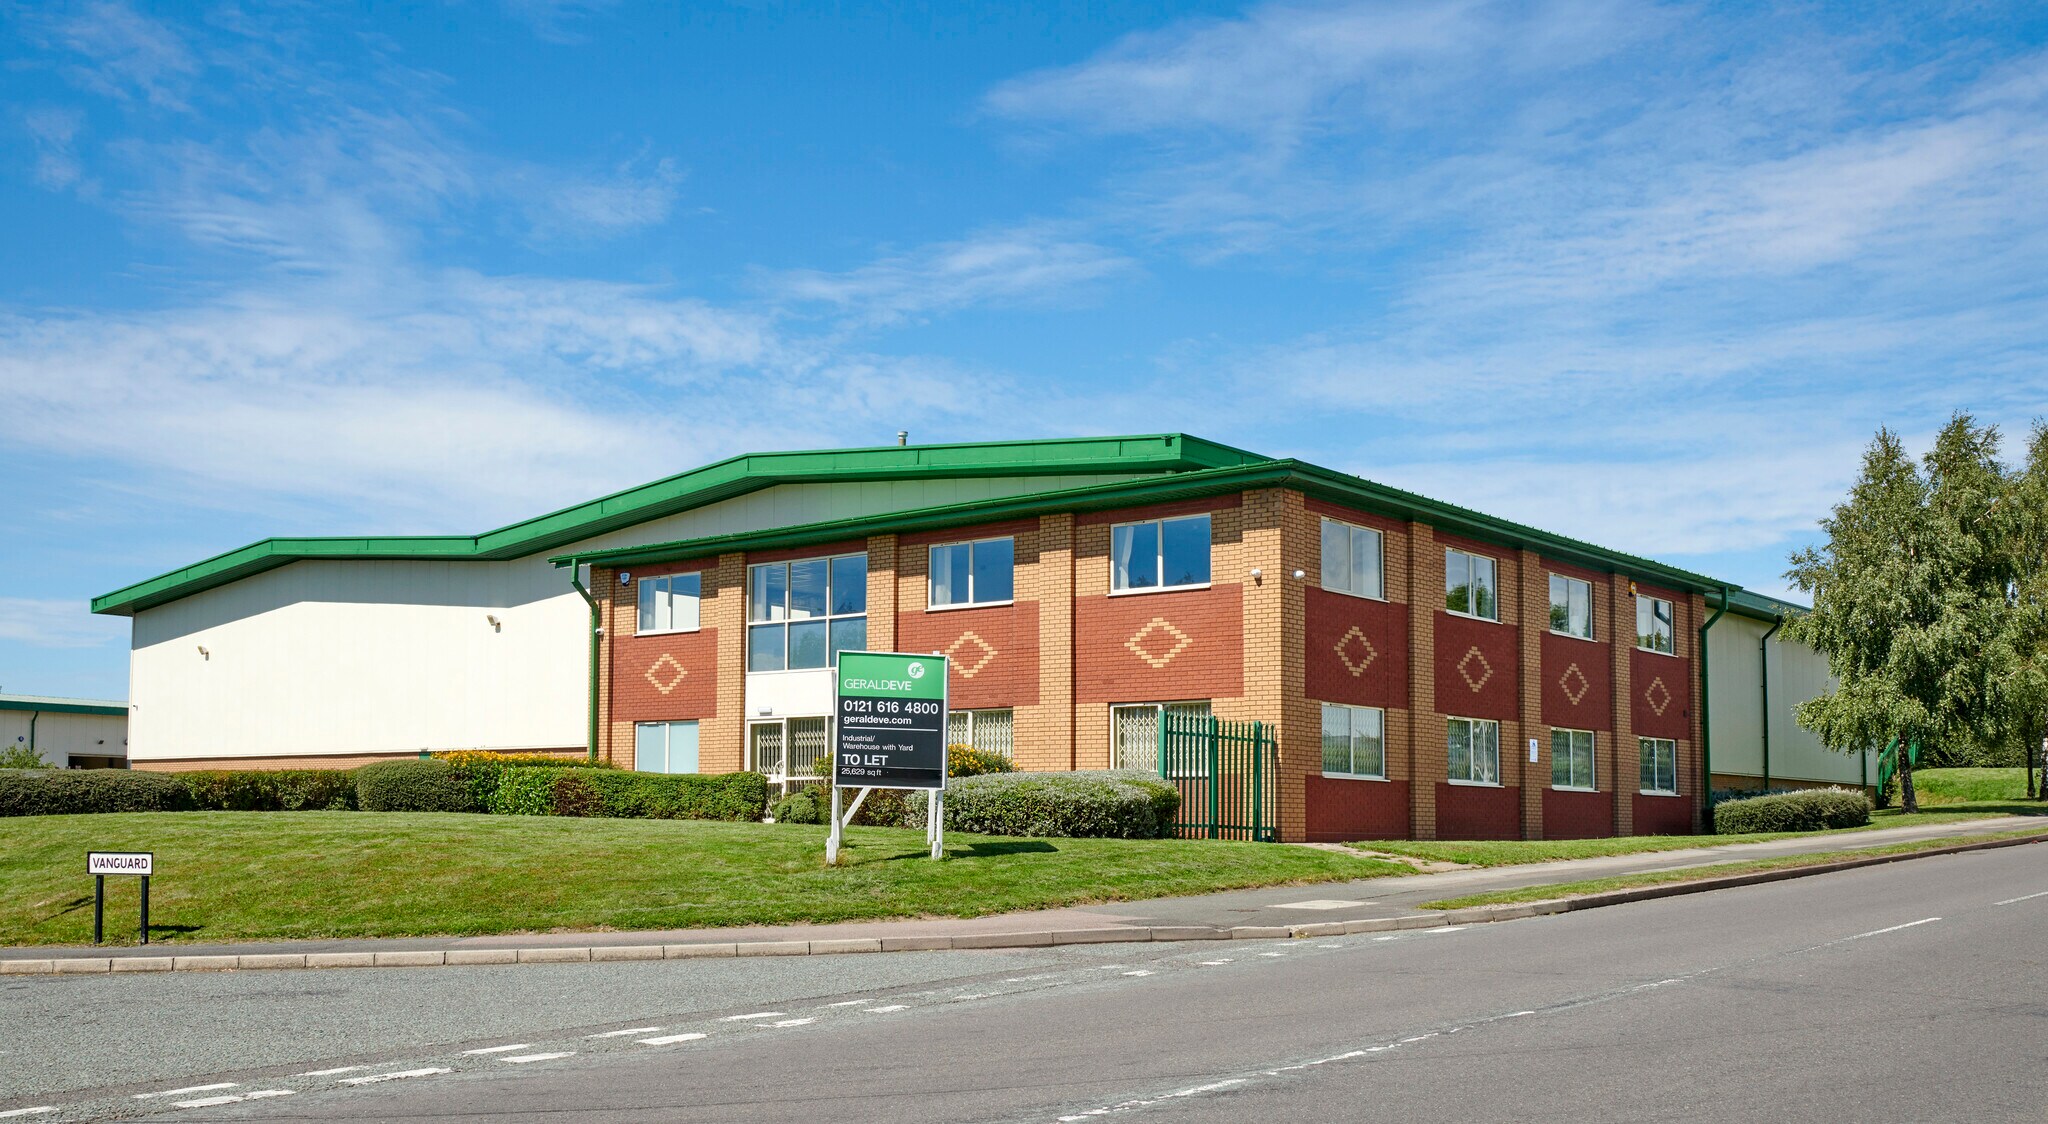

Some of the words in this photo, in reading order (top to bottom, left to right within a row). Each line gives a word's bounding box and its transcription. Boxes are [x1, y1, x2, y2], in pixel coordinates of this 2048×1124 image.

[844, 679, 912, 690] GERALDEVE
[844, 700, 872, 712] 0121
[877, 701, 899, 713] 616
[904, 703, 939, 714] 4800
[844, 715, 912, 724] geraldeve.com
[842, 754, 860, 765] TO
[864, 755, 888, 766] LET
[841, 767, 865, 776] 25,629
[93, 858, 148, 874] VANGUARD
